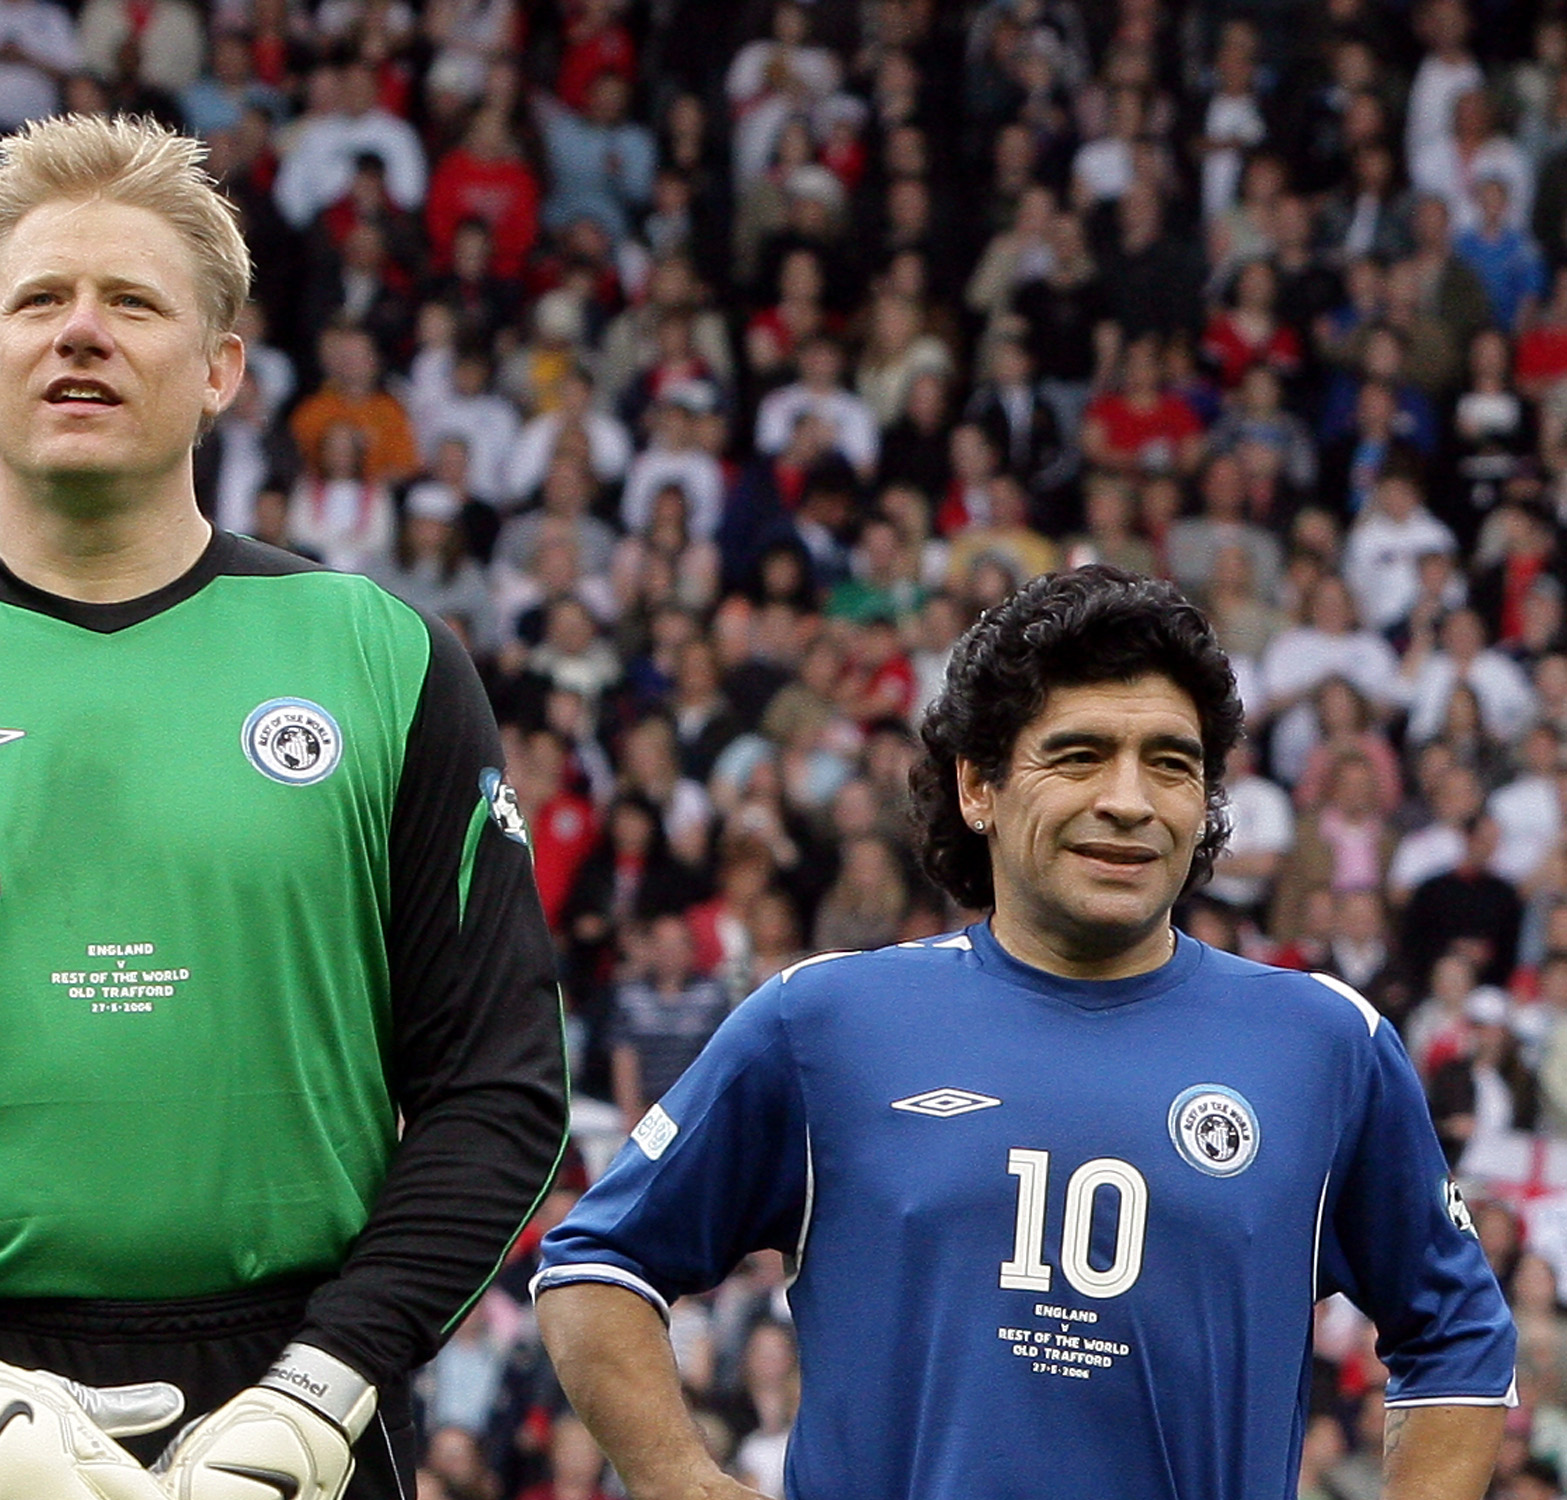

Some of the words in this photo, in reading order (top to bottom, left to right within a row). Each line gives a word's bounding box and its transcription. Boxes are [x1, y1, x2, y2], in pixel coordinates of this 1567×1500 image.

[86, 942, 155, 956] ENGLAND
[50, 972, 87, 985] REST
[88, 972, 109, 984] OF
[111, 971, 139, 984] THE
[141, 968, 191, 983] WORLD
[68, 986, 96, 999] OLD
[100, 985, 175, 999] TRAFFORD
[998, 1147, 1149, 1300] 10
[1034, 1303, 1099, 1324] ENGLAND
[997, 1327, 1033, 1343] REST
[1034, 1331, 1053, 1344] OF
[1054, 1333, 1081, 1350] THE
[1083, 1337, 1131, 1356] WORLD
[1012, 1344, 1039, 1358] OLD
[1043, 1347, 1113, 1368] TRAFFORD
